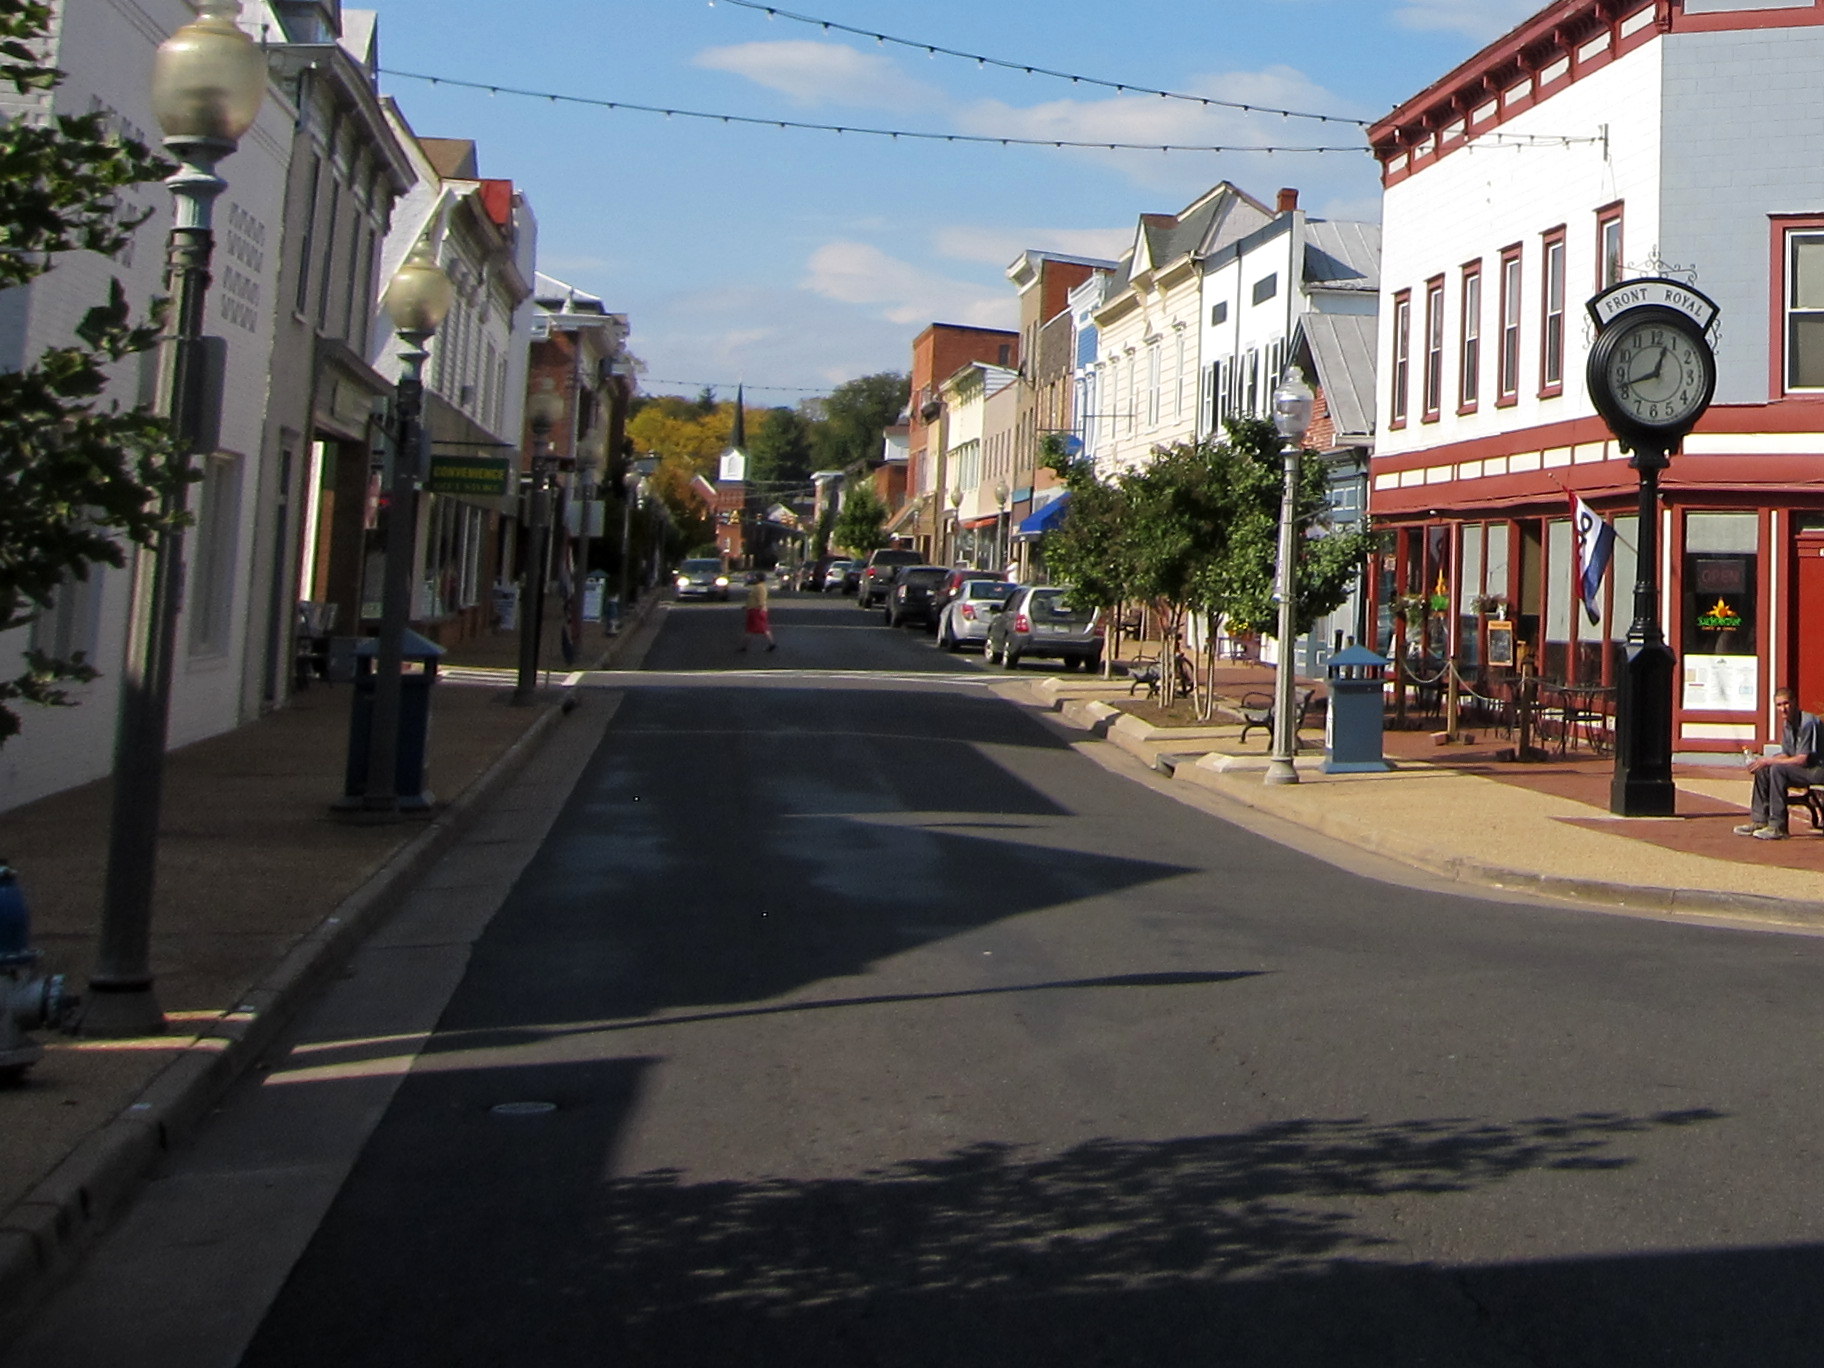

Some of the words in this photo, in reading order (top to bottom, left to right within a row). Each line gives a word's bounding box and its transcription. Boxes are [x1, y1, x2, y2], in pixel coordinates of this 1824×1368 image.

[1605, 288, 1647, 313] FRONT
[1664, 289, 1703, 317] ROYAL
[1633, 334, 1641, 348] 11
[1651, 330, 1663, 345] 12
[1620, 349, 1631, 363] 10
[1684, 350, 1692, 364] 2
[1616, 366, 1625, 383] 9
[1686, 369, 1694, 386] 3
[1680, 389, 1688, 405] 4
[1634, 400, 1641, 415] 7
[1649, 404, 1657, 419] 6
[1665, 402, 1673, 416] 5
